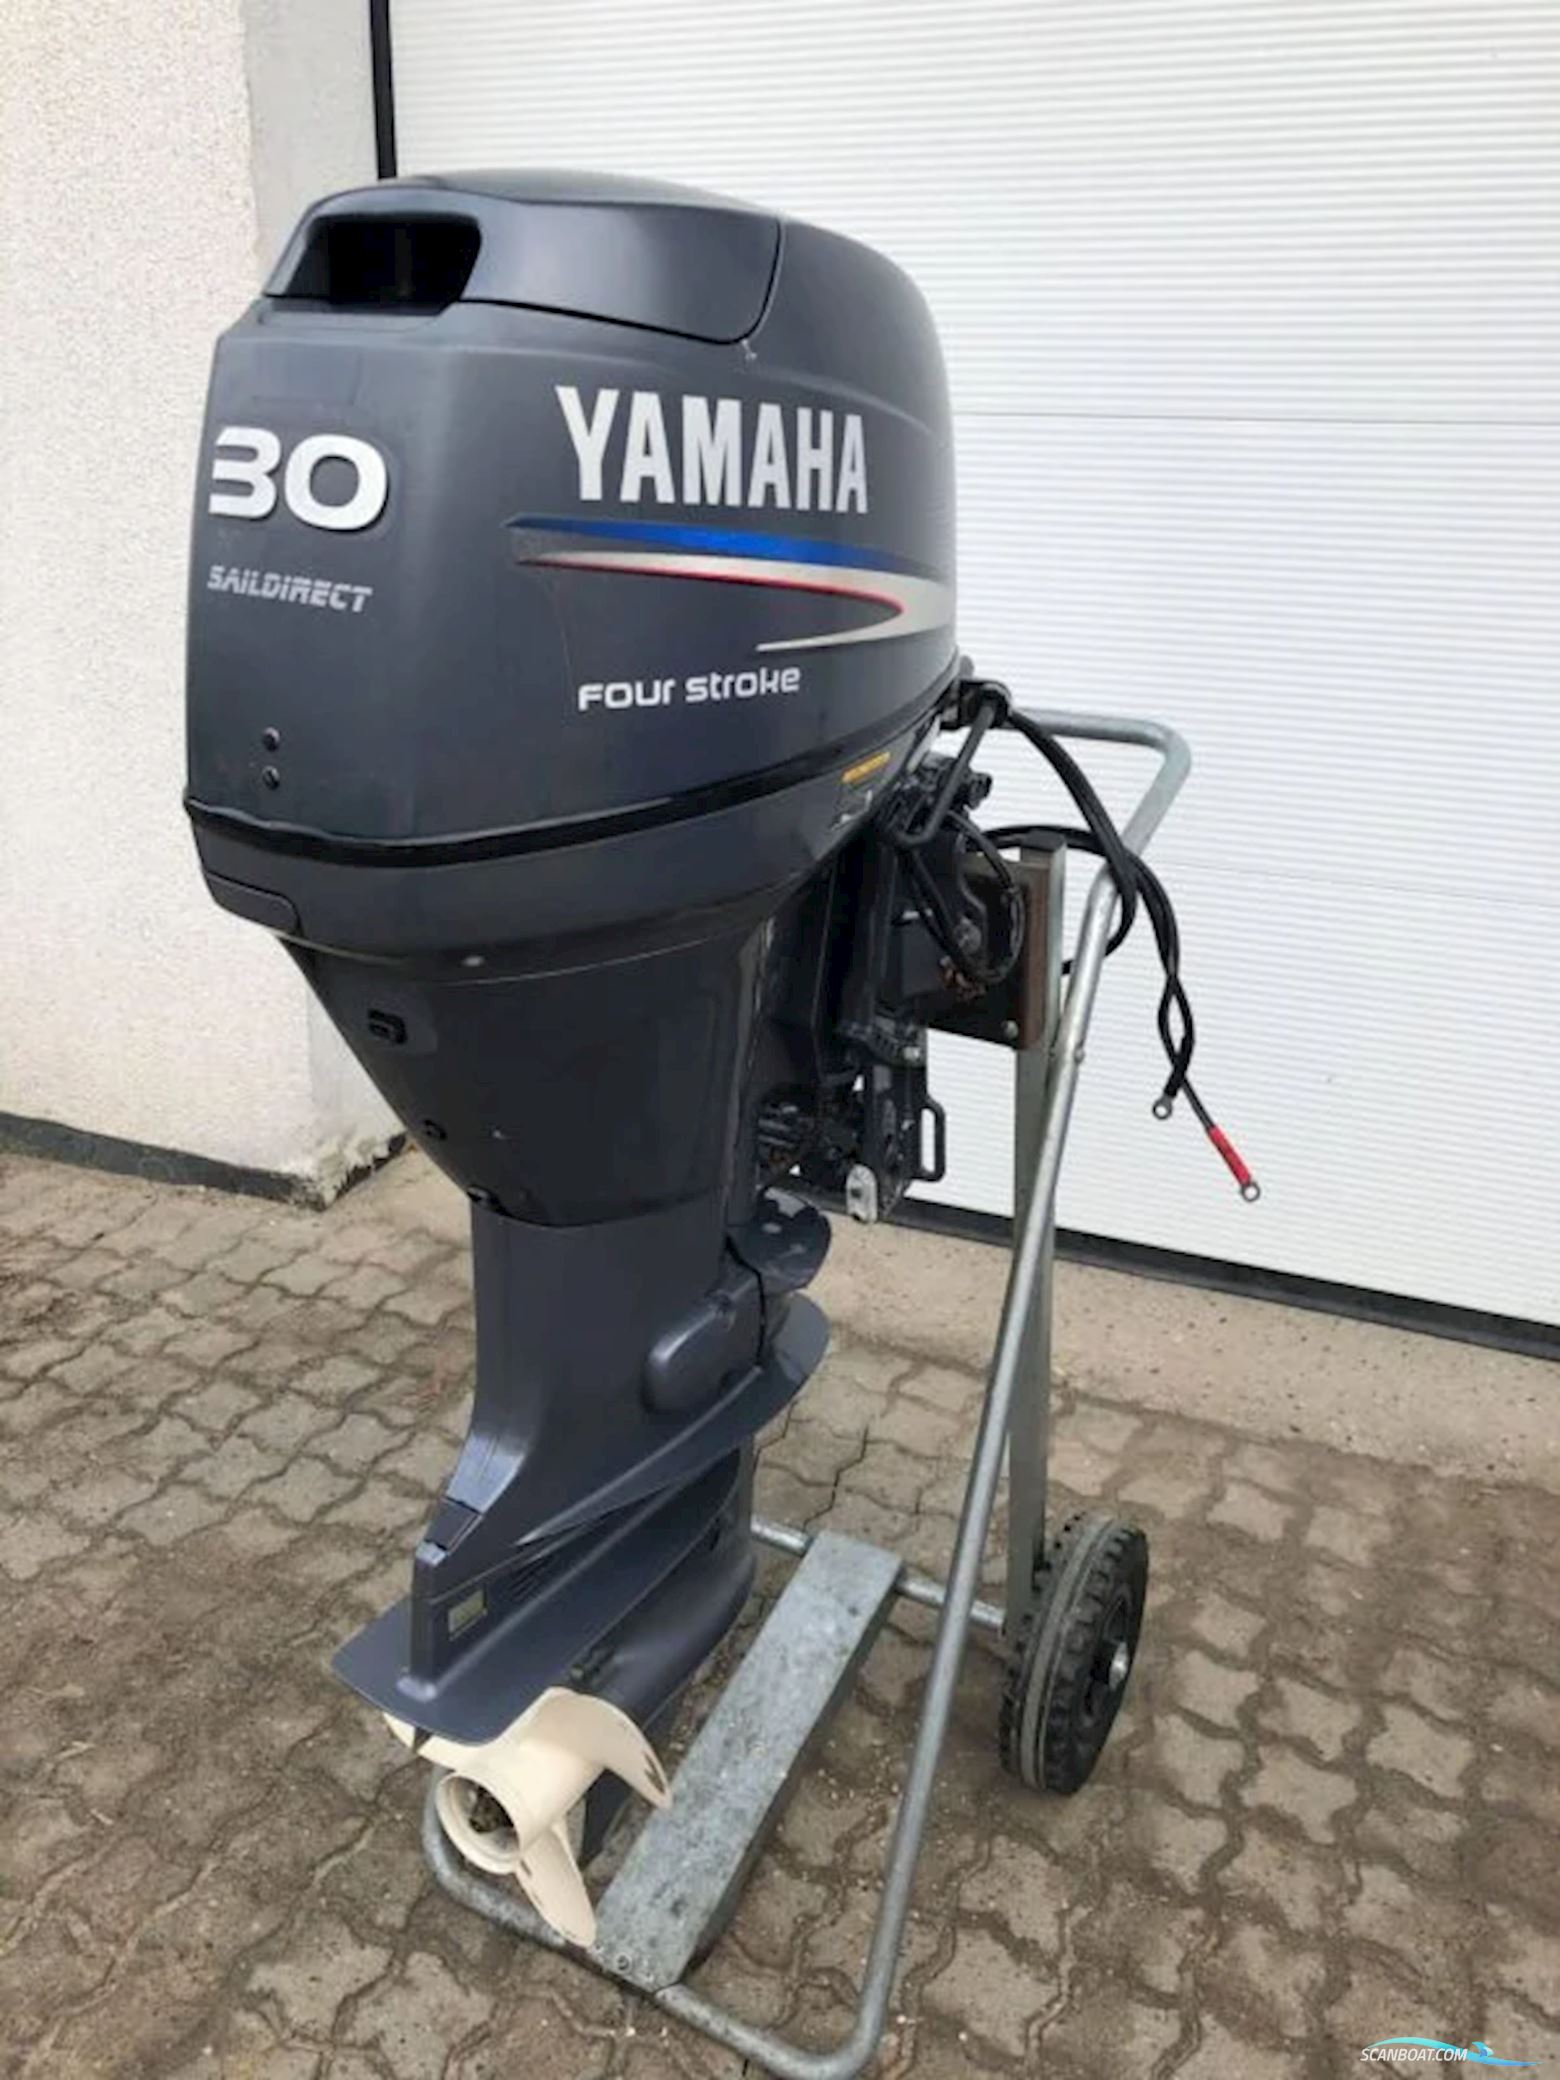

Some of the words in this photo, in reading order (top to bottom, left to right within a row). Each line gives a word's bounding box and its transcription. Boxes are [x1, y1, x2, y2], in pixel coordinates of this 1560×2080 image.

[208, 426, 388, 531] 30
[555, 385, 868, 514] YAMAHA
[207, 565, 373, 613] SAILDIRECT
